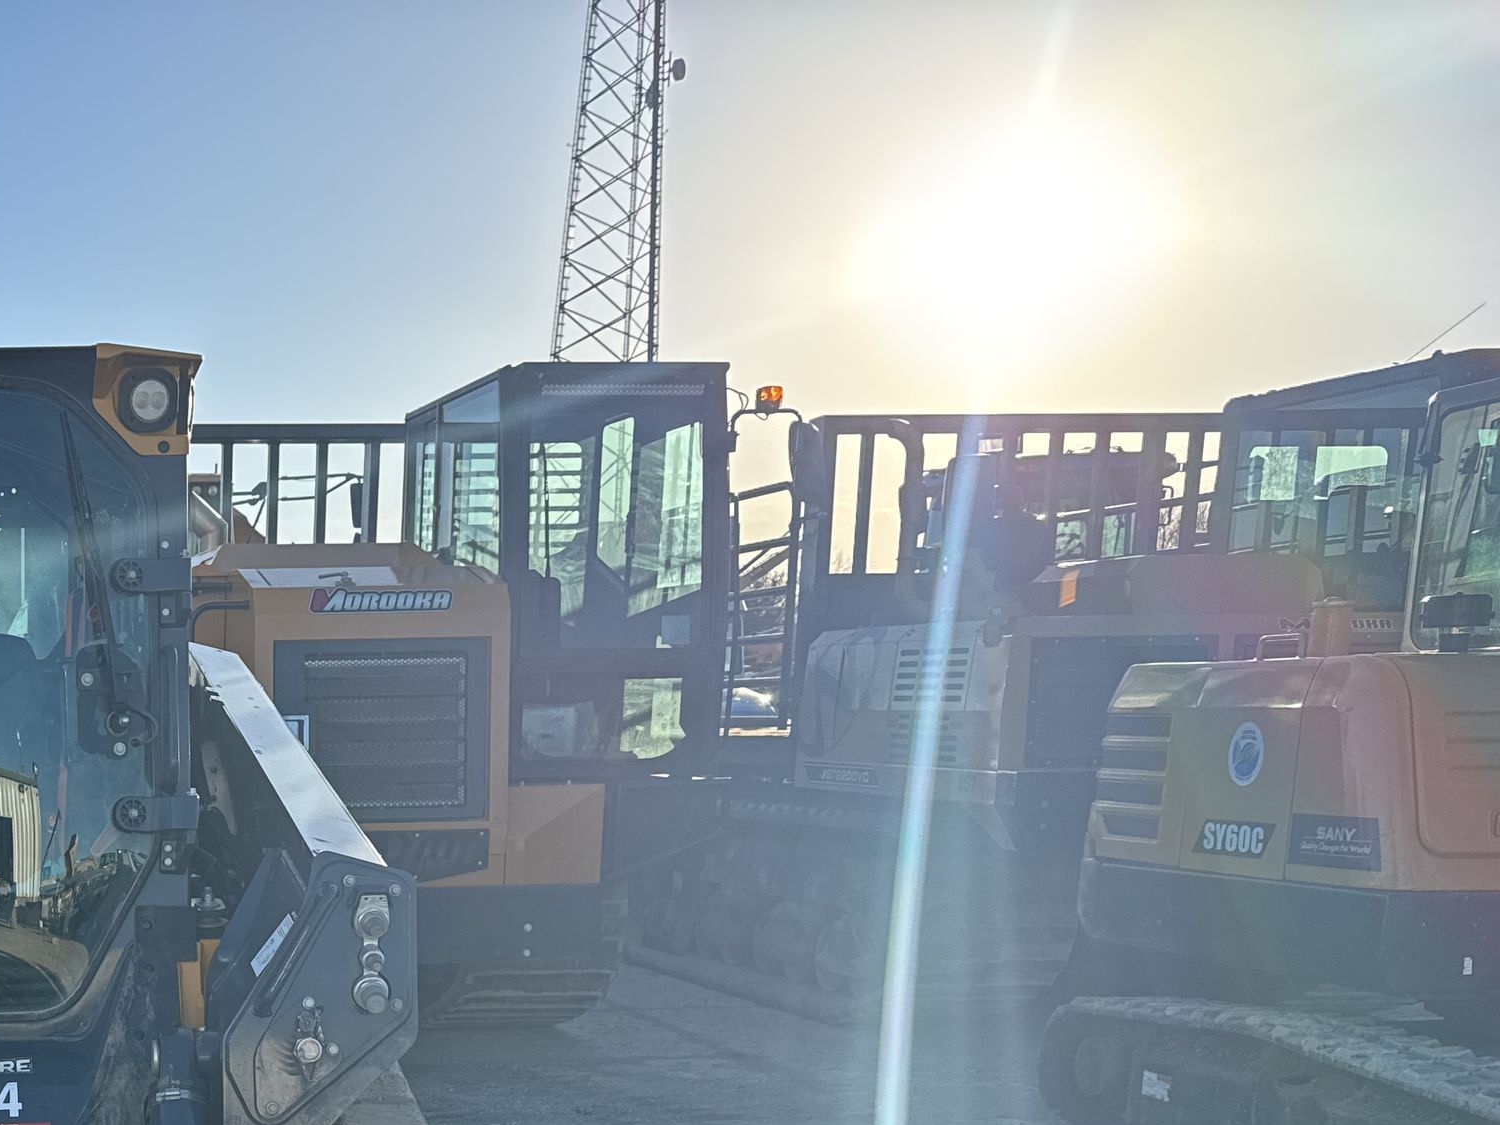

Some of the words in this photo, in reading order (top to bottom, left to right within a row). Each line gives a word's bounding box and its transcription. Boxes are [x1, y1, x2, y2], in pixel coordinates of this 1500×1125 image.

[311, 588, 453, 612] MOROOKA
[1202, 821, 1265, 855] SY60C
[1316, 825, 1357, 842] SANY
